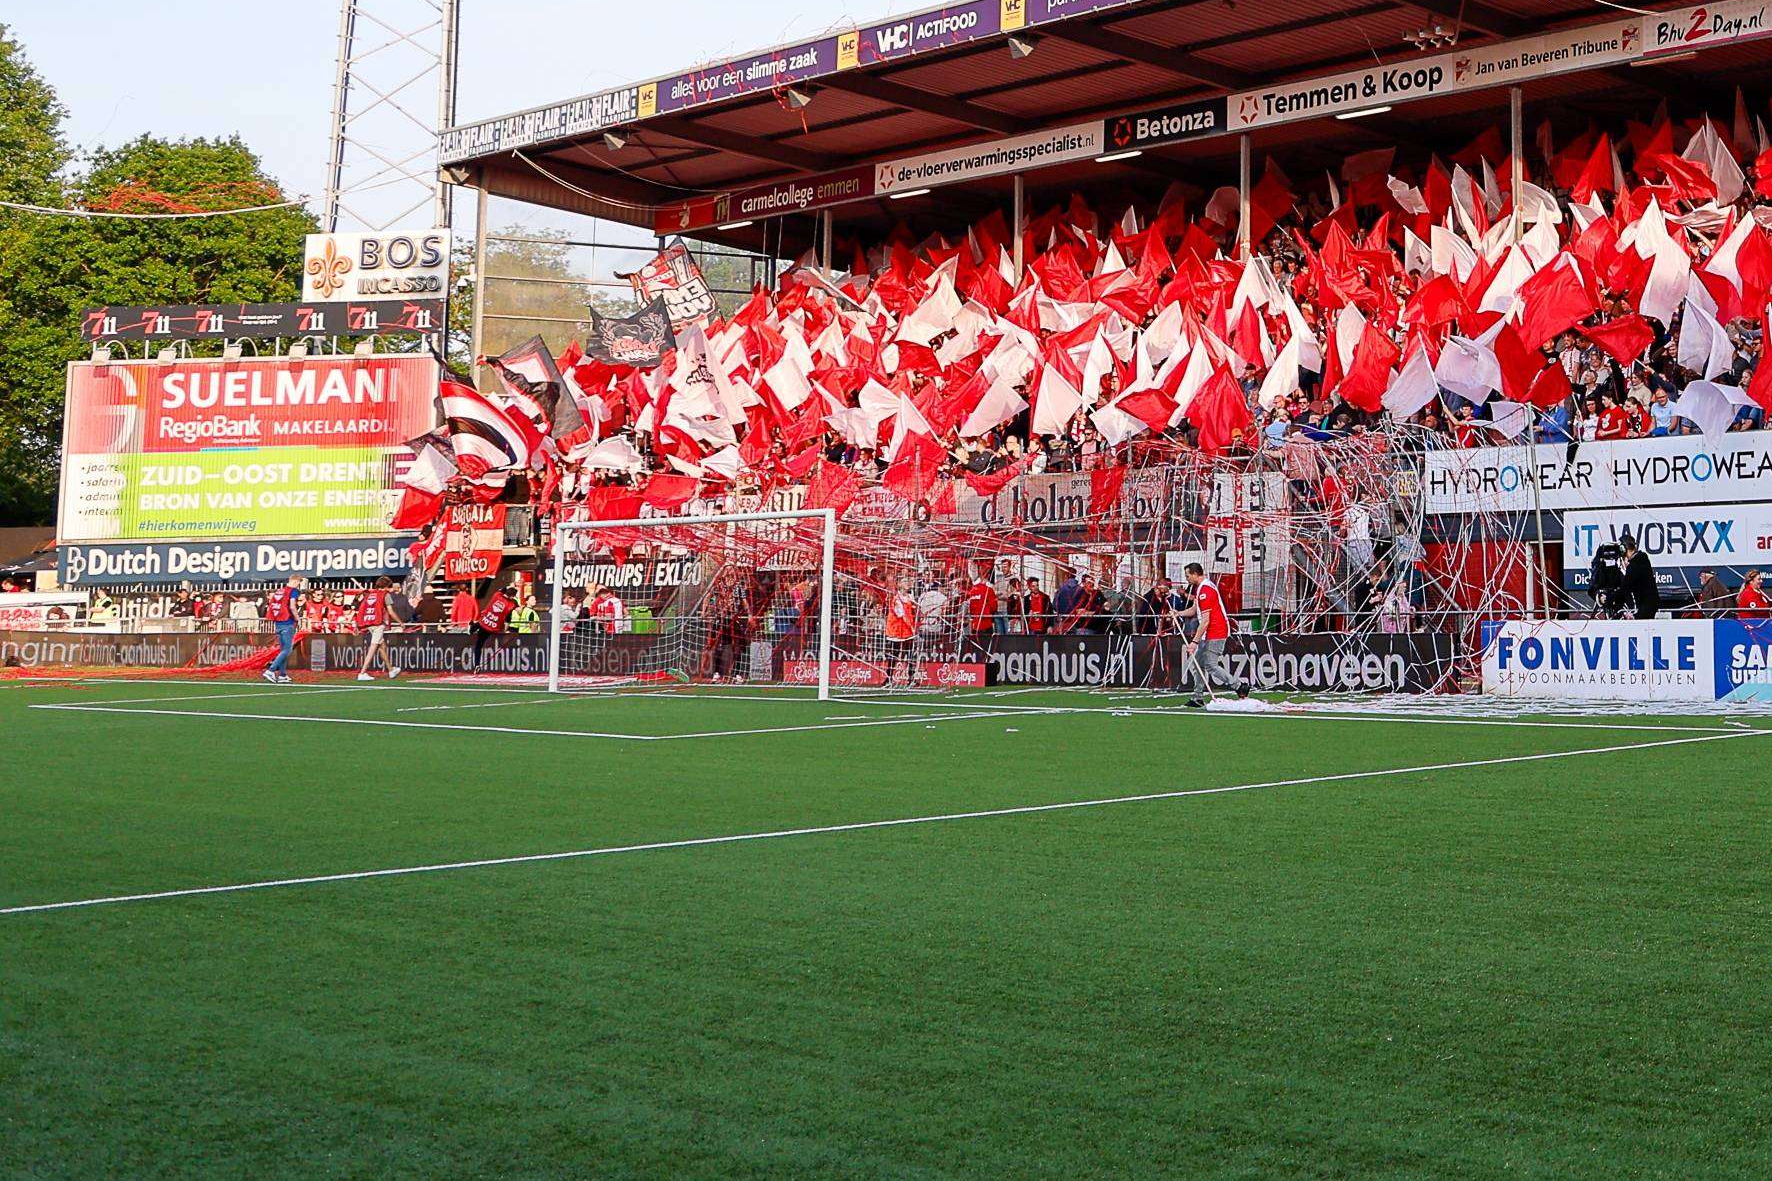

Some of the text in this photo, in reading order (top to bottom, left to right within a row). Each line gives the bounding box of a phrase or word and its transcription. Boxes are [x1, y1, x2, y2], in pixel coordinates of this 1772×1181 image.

[876, 11, 977, 54] VHC ACTIFOOD
[671, 47, 818, 100] alles voor een slimme zaak
[1475, 38, 1618, 76] Jan van Beveren Tribune
[602, 89, 630, 117] FLAIR
[1263, 64, 1444, 117] Temmen & Koop
[470, 123, 494, 148] FLAIR
[534, 107, 560, 132] FLAIR
[1136, 109, 1215, 140] Betonza
[898, 133, 1095, 182] de-vloerverwarmingsspecialist.nl
[741, 177, 859, 214] carmelcollege emmen
[359, 235, 443, 270] BOS
[357, 274, 441, 295] INCASSO
[159, 415, 261, 444] RegioBank
[300, 461, 382, 483] DRENT
[1429, 460, 1594, 496] HYDROWEAR
[139, 493, 200, 511] BRON
[206, 492, 254, 509] VAN
[258, 490, 318, 508] ONZE
[138, 517, 257, 533] #hierkomenwijweg
[1574, 519, 1736, 557] IT WORXX
[88, 545, 161, 576] Dutch
[168, 543, 250, 576] Design
[257, 537, 413, 574] Deurpanelen
[563, 562, 645, 589] SCHUTRUPS
[1181, 644, 1406, 687] Kazienaveen
[1498, 635, 1697, 671] FONVILLE
[836, 662, 977, 686] EasyToys EasyToys
[1498, 671, 1697, 688] SCHOONMAAKBEDRIJVEN
